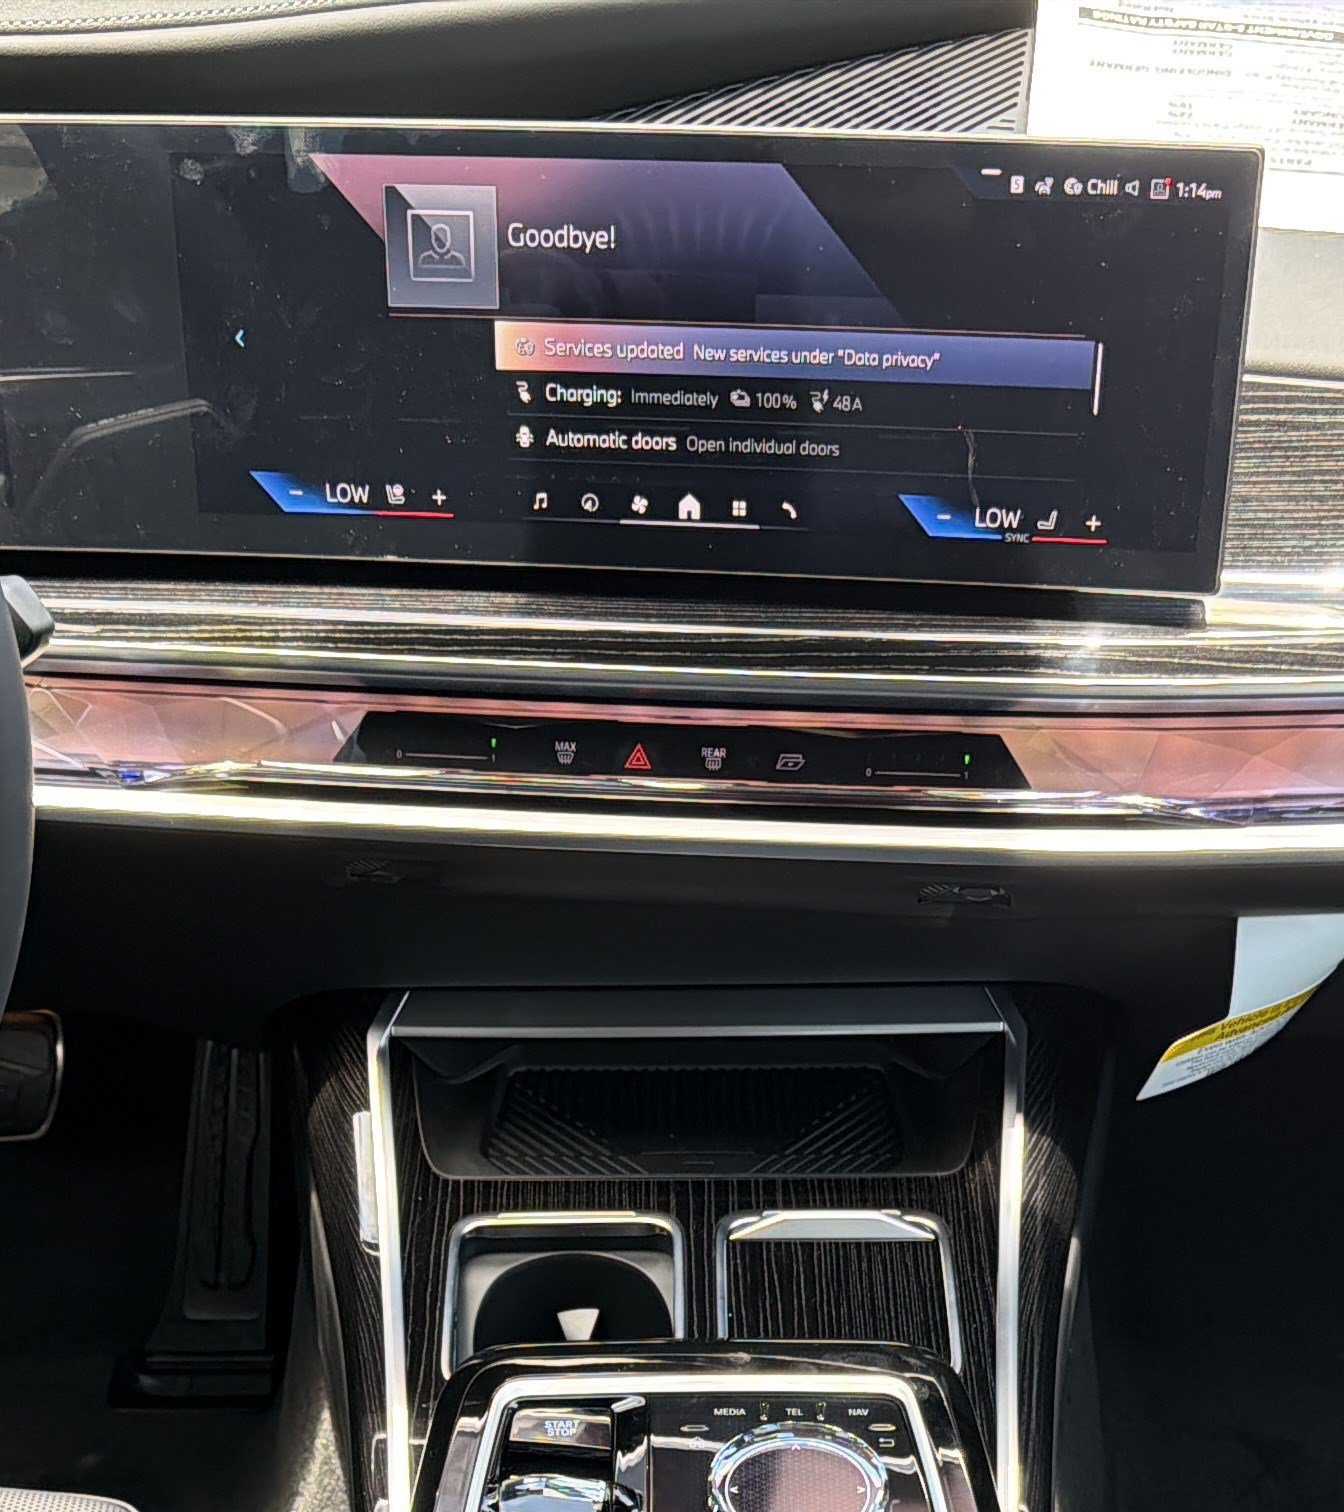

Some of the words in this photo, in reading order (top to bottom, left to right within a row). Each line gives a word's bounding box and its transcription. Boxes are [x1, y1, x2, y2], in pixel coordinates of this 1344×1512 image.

[1087, 178, 1118, 196] Chill
[507, 222, 616, 254] Goodbye!
[544, 337, 613, 358] Services
[616, 340, 685, 362] updated
[693, 343, 726, 362] New
[729, 346, 788, 364] services
[792, 347, 835, 366] under
[545, 383, 623, 408] Charging:
[631, 387, 720, 410] Immediately
[546, 428, 629, 450] Automatic
[631, 431, 677, 451] doors
[687, 435, 725, 455] Open
[729, 437, 796, 455] individual
[800, 440, 841, 457] doors
[326, 482, 370, 504] LOW
[974, 506, 1022, 529] LOW
[1005, 533, 1031, 544] SYNC
[555, 740, 577, 752] MAX
[701, 747, 727, 759] REAR
[714, 1408, 747, 1416] MEDIA
[785, 1408, 804, 1416] TEL
[848, 1408, 869, 1416] NAV
[544, 1420, 581, 1429] START
[547, 1428, 577, 1437] STOP
